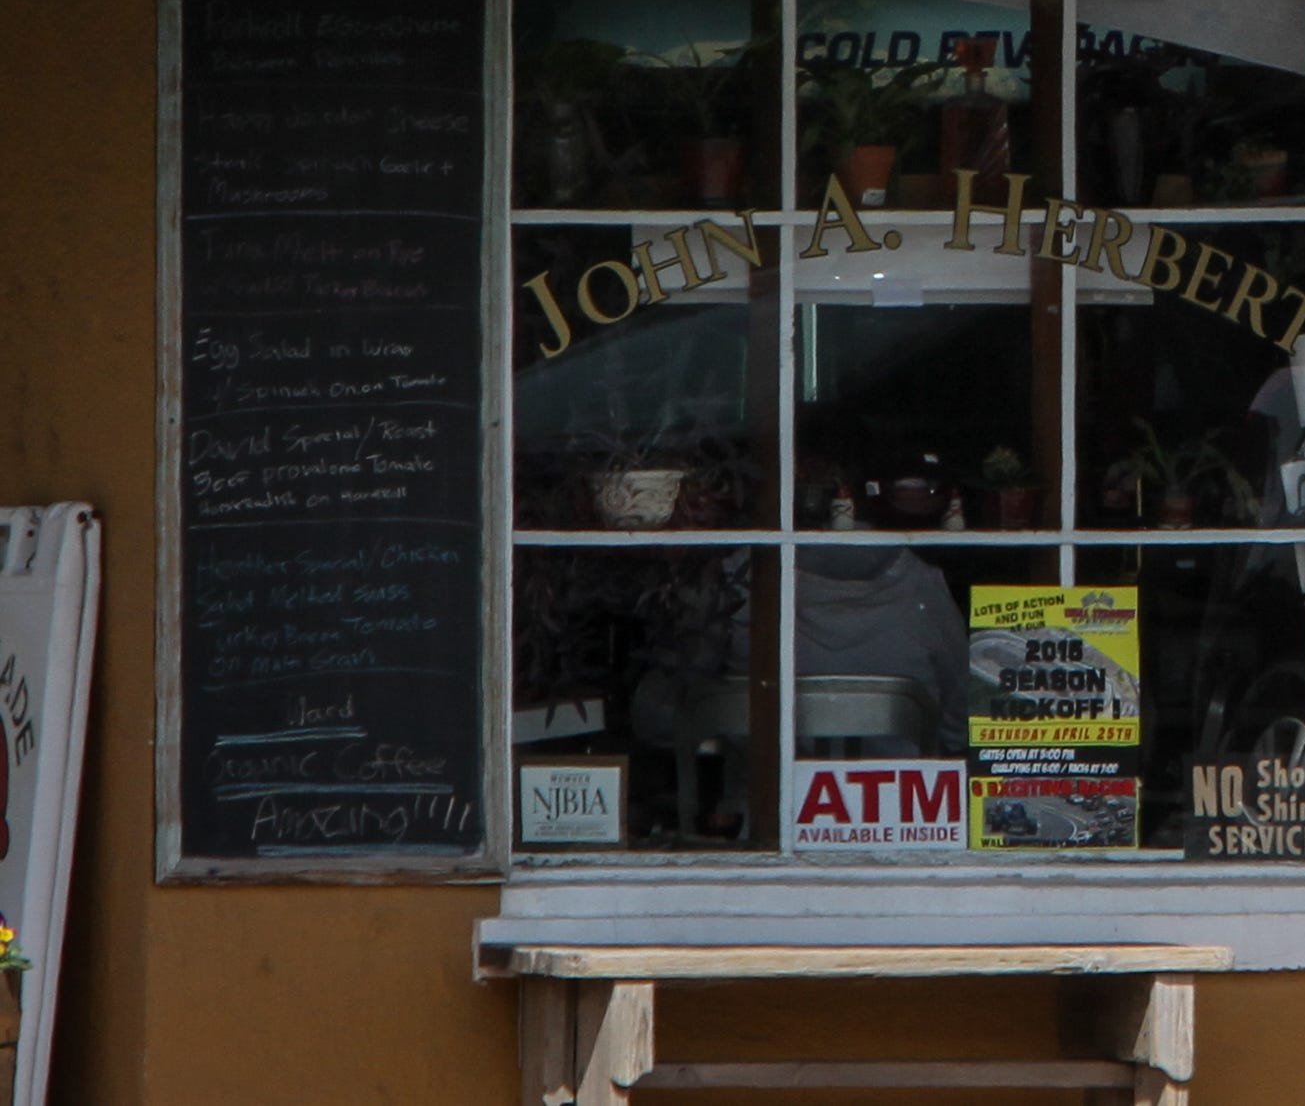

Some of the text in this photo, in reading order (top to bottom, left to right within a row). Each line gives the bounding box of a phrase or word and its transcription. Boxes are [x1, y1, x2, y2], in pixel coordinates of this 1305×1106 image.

[797, 30, 920, 68] COLD
[802, 173, 903, 259] A.
[192, 327, 241, 370] Egg
[188, 425, 272, 466] David
[995, 609, 1044, 625] AND FUN
[1005, 601, 1020, 612] OF
[1023, 594, 1065, 609] ACTION
[999, 667, 1105, 692] SEASON
[990, 698, 1104, 721] KICKOFF
[980, 727, 1132, 741] SATURDAY APRIL 25TH
[333, 743, 447, 780] Coffee
[1006, 749, 1028, 761] OPEN
[1027, 749, 1040, 761] AT
[532, 786, 608, 821] NJBIA
[797, 770, 960, 824] ATM
[1192, 765, 1244, 818] NO
[798, 826, 959, 843] AVAILABLE INSIDE
